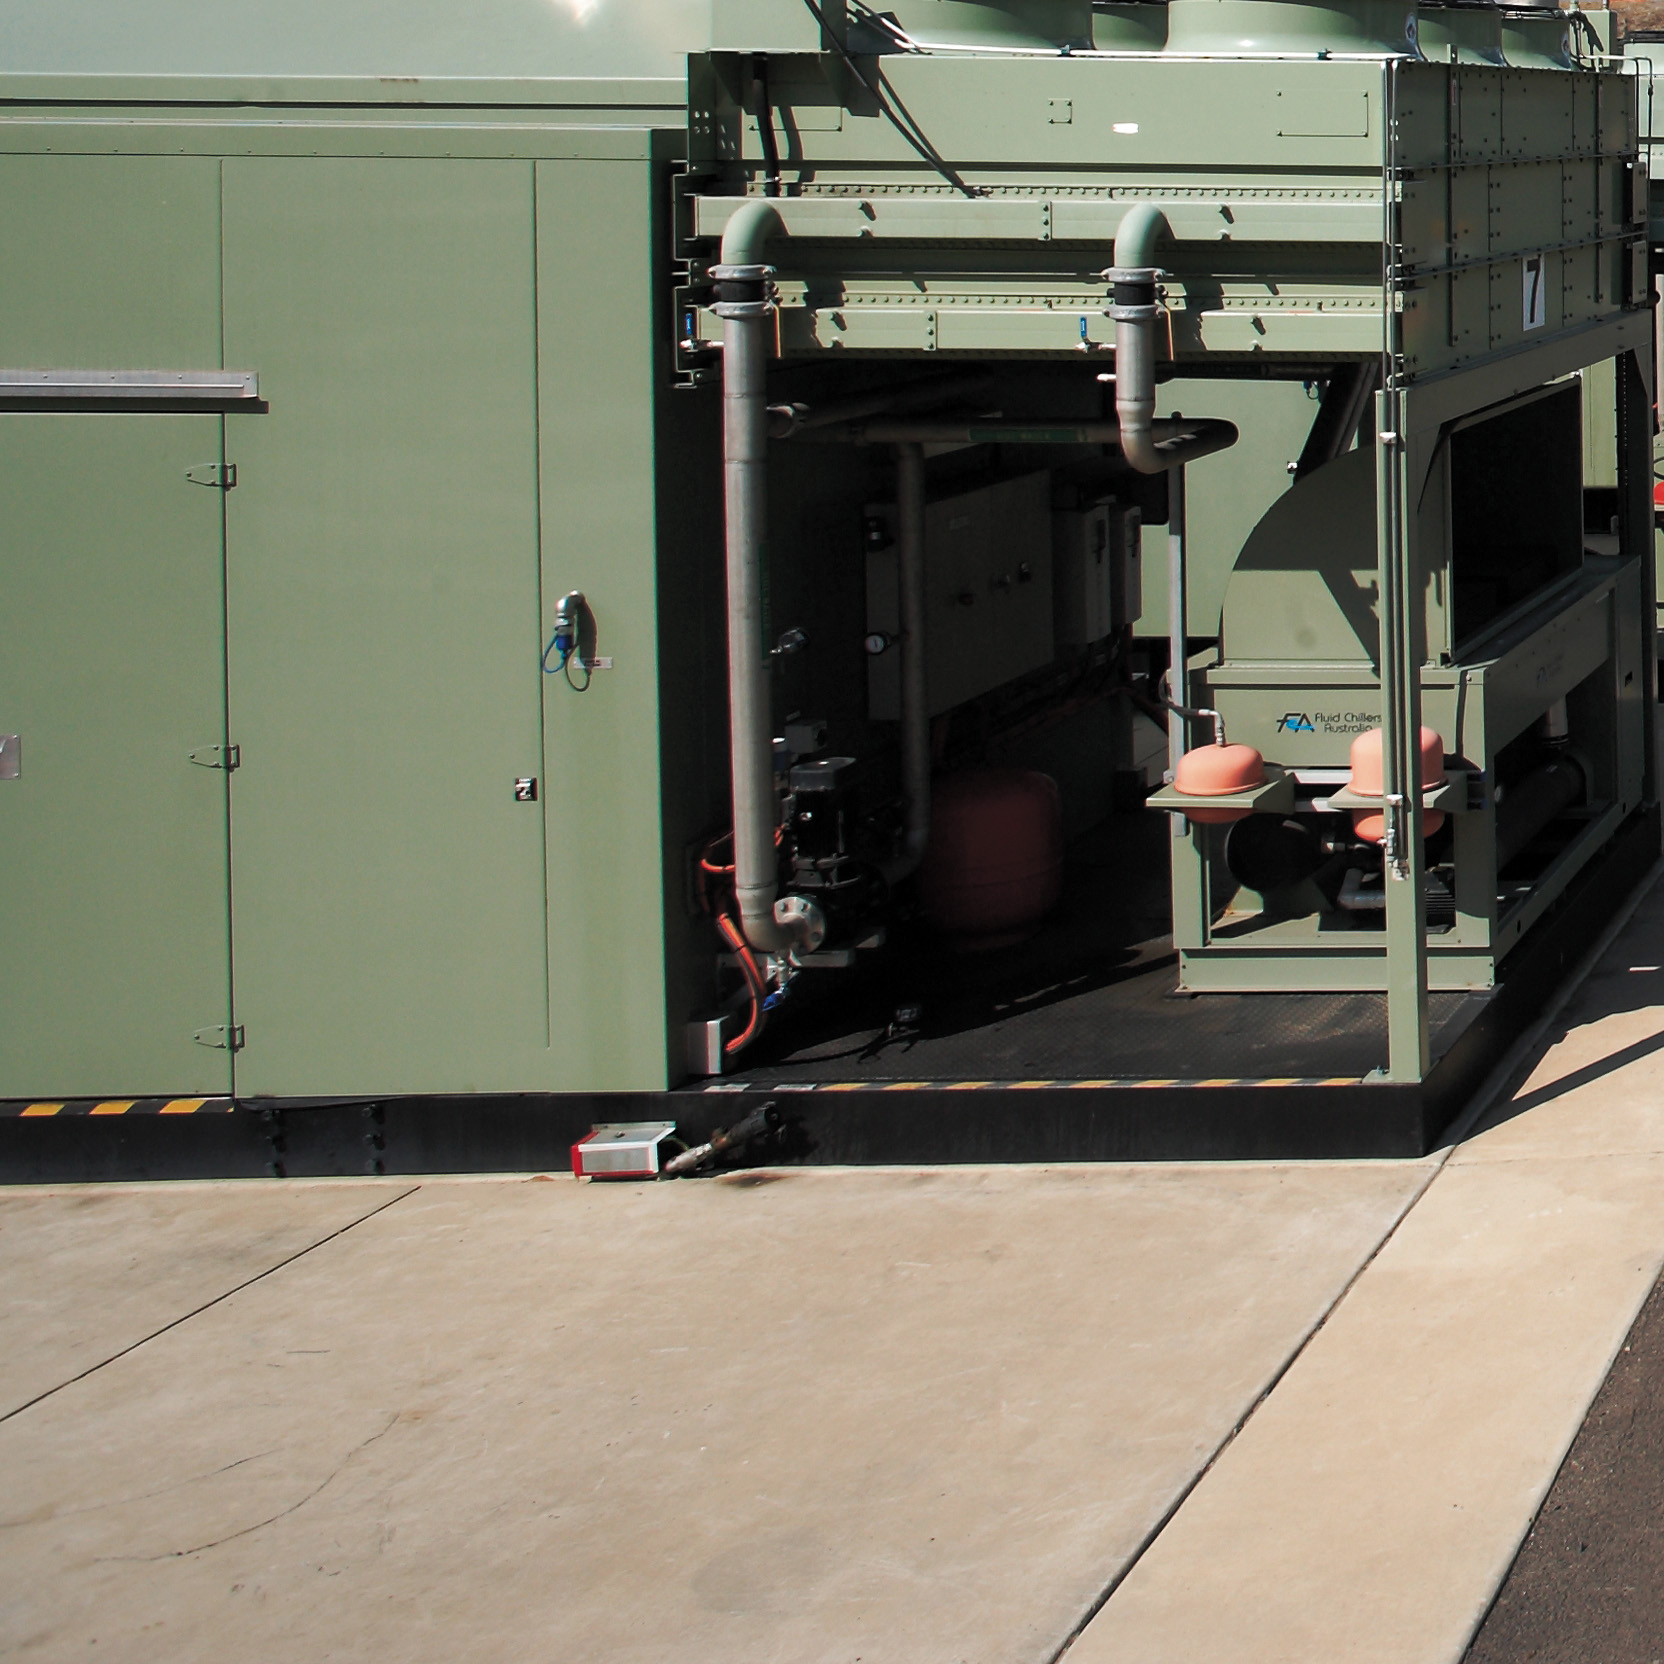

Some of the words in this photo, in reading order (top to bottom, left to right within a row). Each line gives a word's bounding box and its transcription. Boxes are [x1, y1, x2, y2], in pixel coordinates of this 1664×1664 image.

[1526, 254, 1542, 324] 7
[1314, 712, 1340, 723] Fluid
[1344, 712, 1382, 723] Chillers
[1324, 723, 1373, 733] Australia
